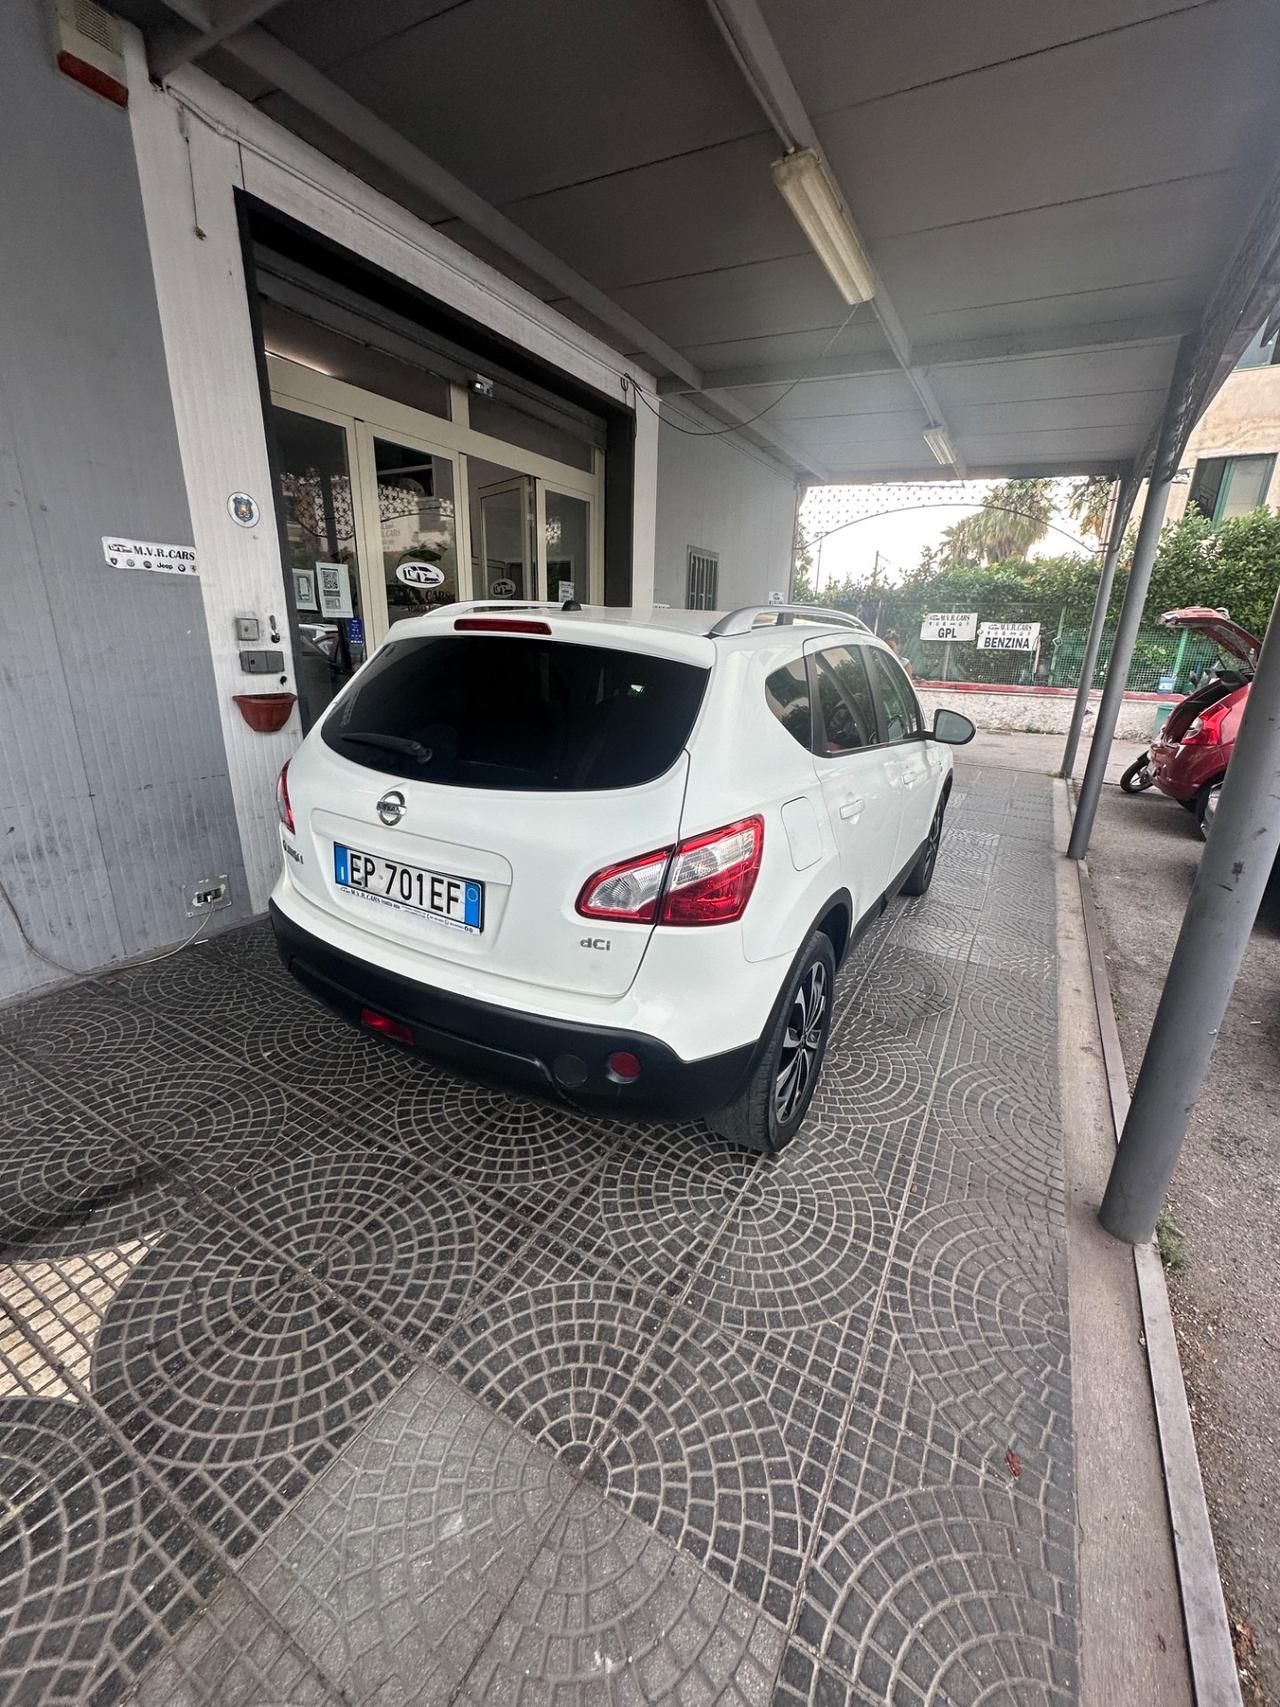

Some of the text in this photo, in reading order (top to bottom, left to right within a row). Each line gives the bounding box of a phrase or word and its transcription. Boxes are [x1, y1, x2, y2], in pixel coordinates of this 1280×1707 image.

[157, 562, 173, 570] Jeep
[938, 627, 957, 638] GPL
[984, 637, 1030, 649] BENZINA
